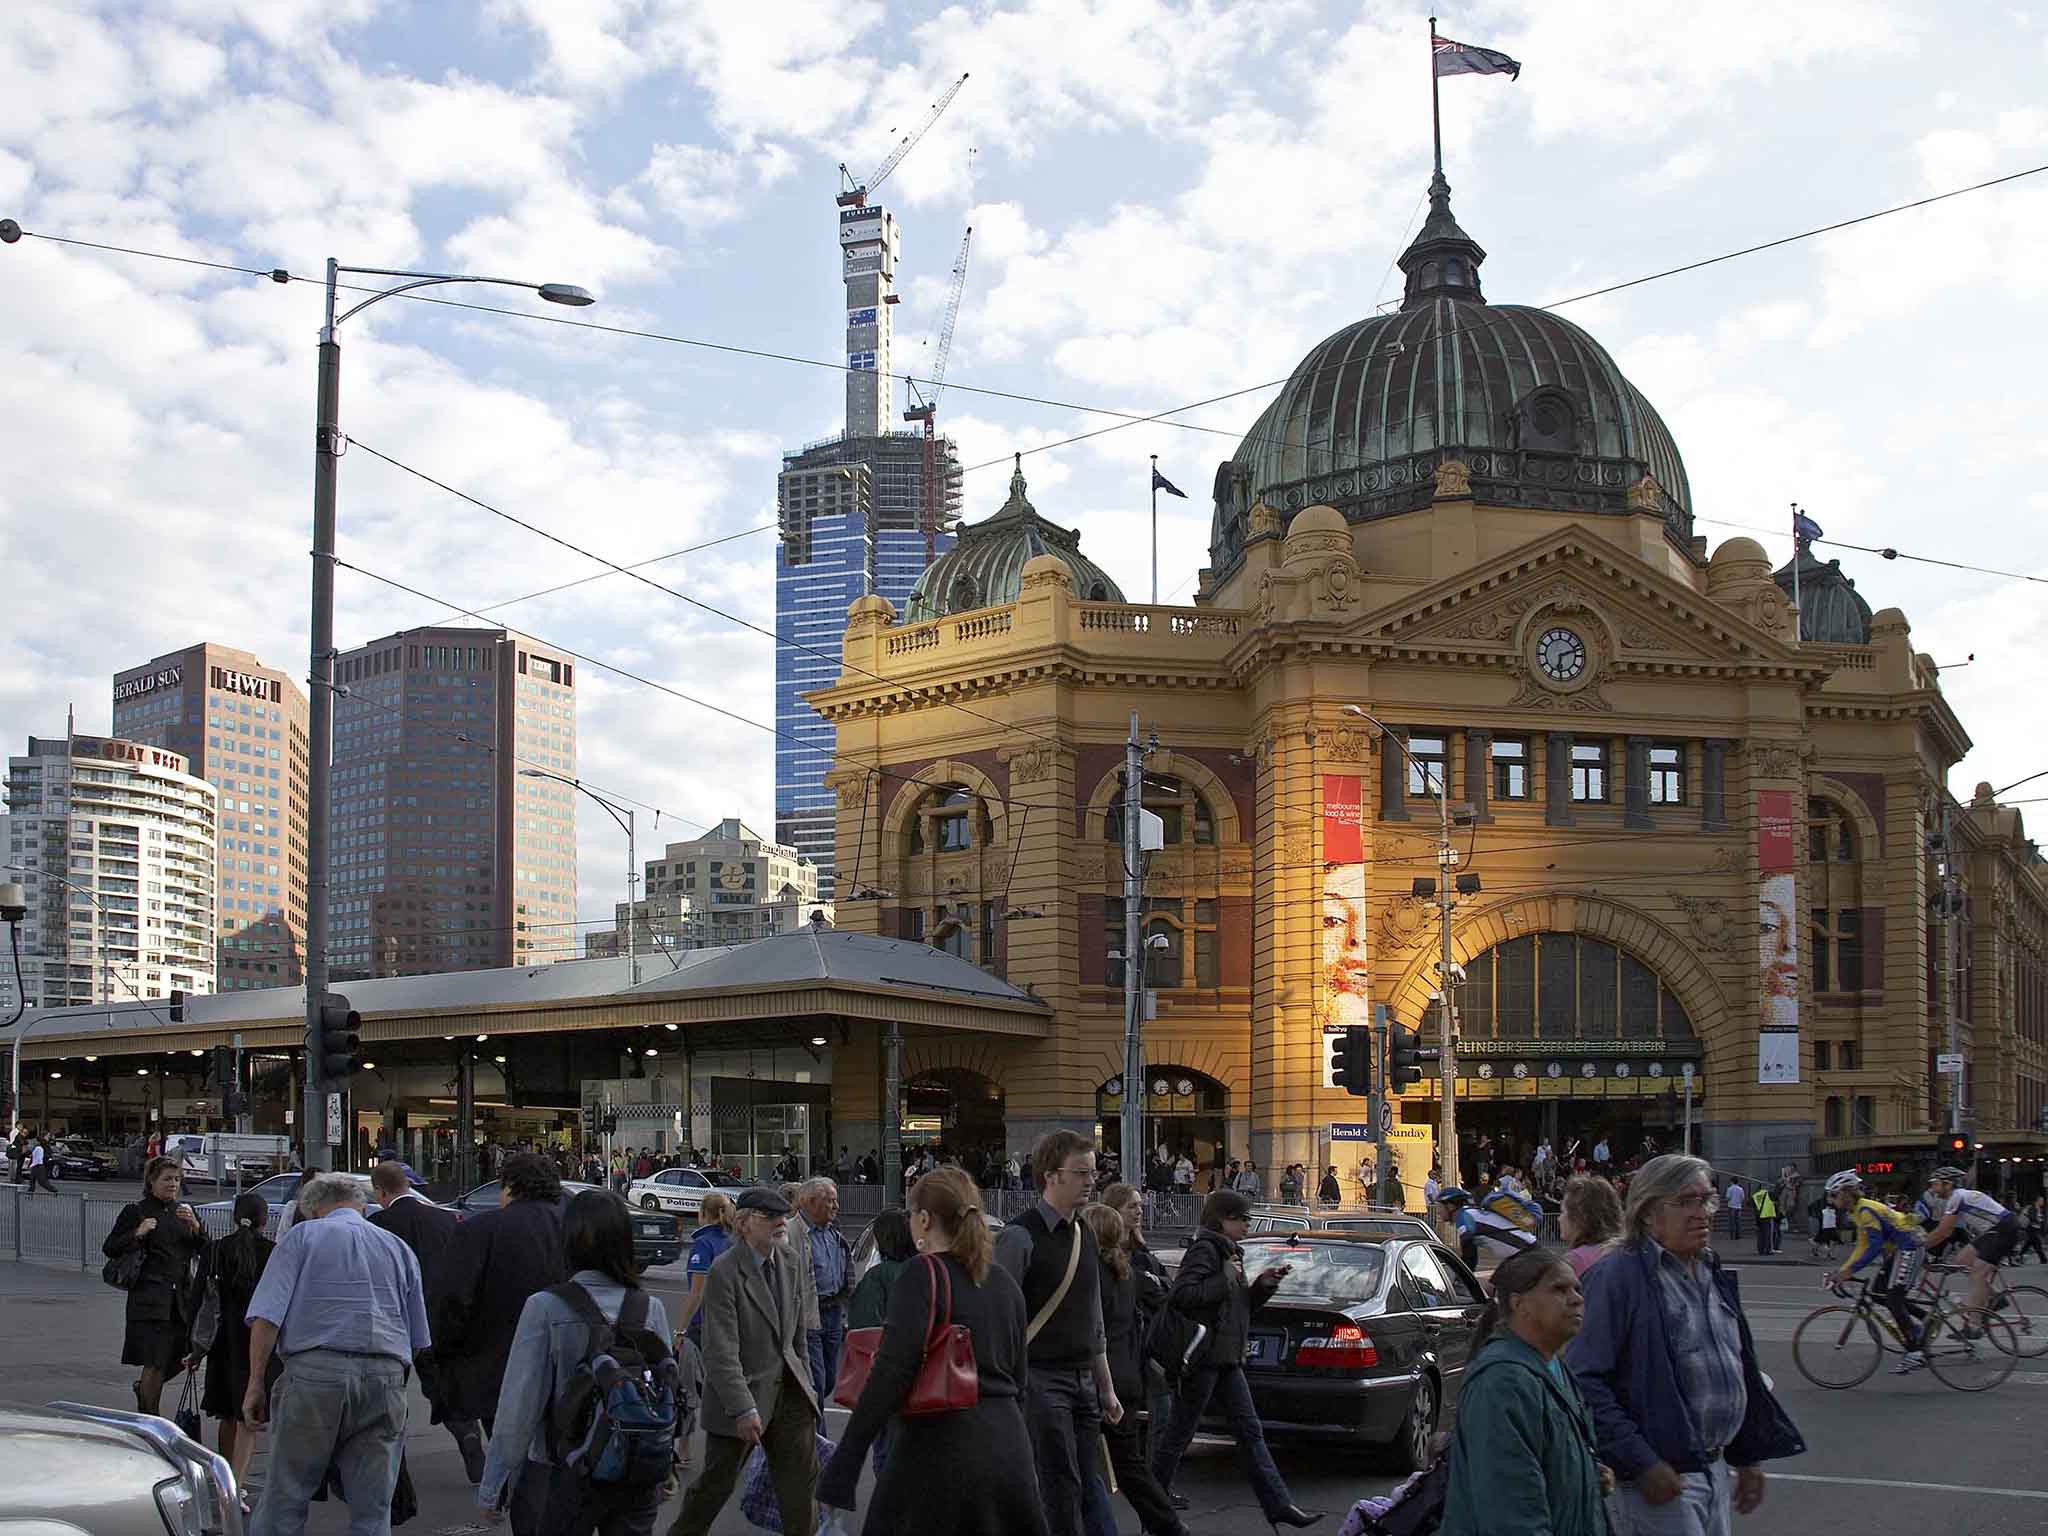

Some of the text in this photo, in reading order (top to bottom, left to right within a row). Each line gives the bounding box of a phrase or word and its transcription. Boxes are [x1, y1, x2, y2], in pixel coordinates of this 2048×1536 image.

[114, 667, 180, 699] HERALD SUN
[103, 743, 181, 772] QUAY WEST
[1456, 1041, 1667, 1053] FLINDERS STREET STATION
[1332, 1128, 1361, 1137] Herald
[1386, 1127, 1425, 1140] Sunday
